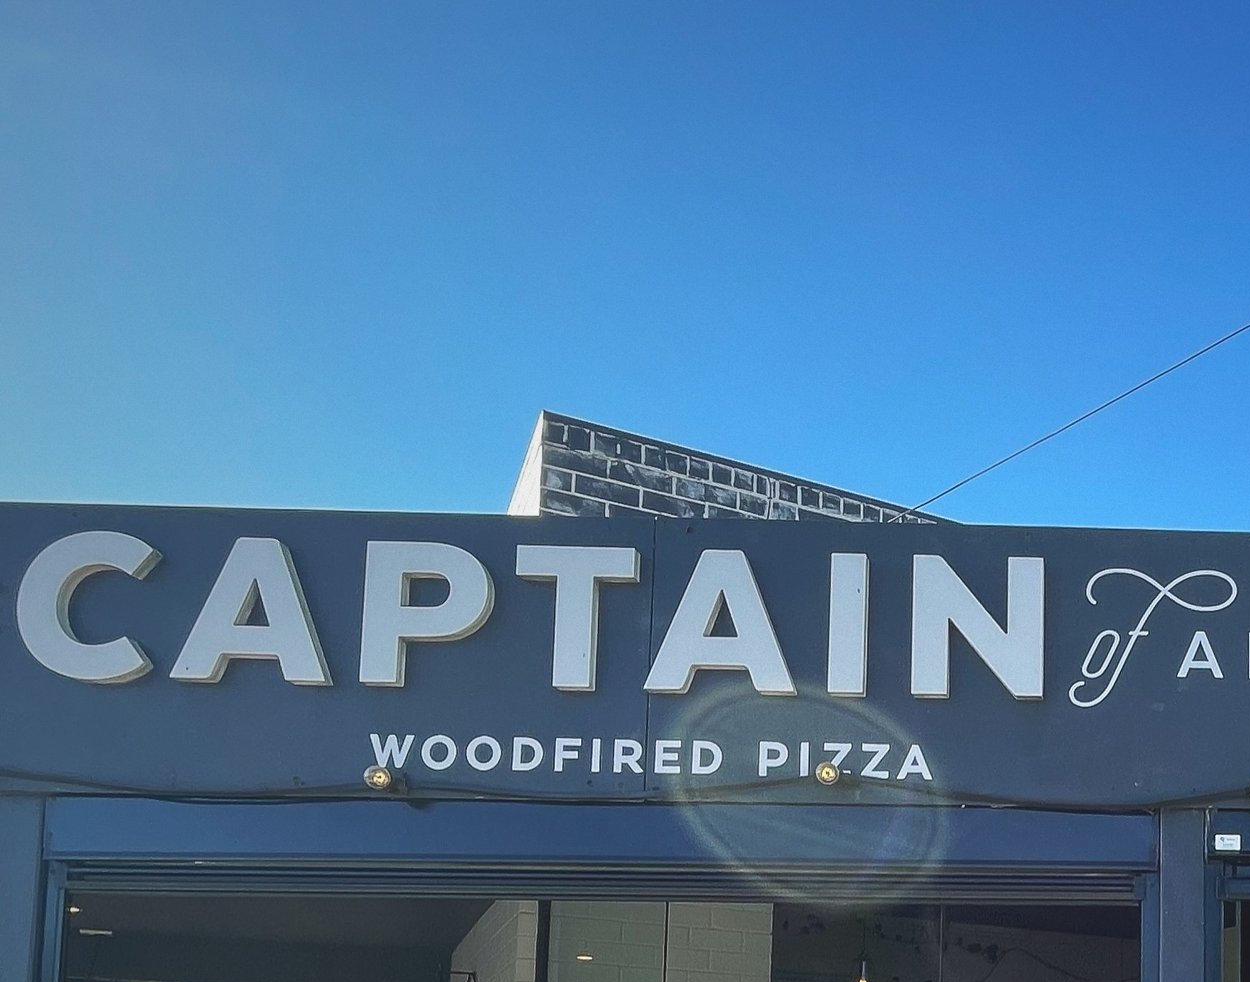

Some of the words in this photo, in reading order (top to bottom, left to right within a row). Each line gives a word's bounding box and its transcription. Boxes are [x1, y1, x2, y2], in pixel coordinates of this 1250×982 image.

[16, 530, 1045, 700] CAPTAIN
[1068, 568, 1238, 707] of
[370, 733, 724, 776] WOODFIRED
[757, 740, 934, 781] PIZZA
